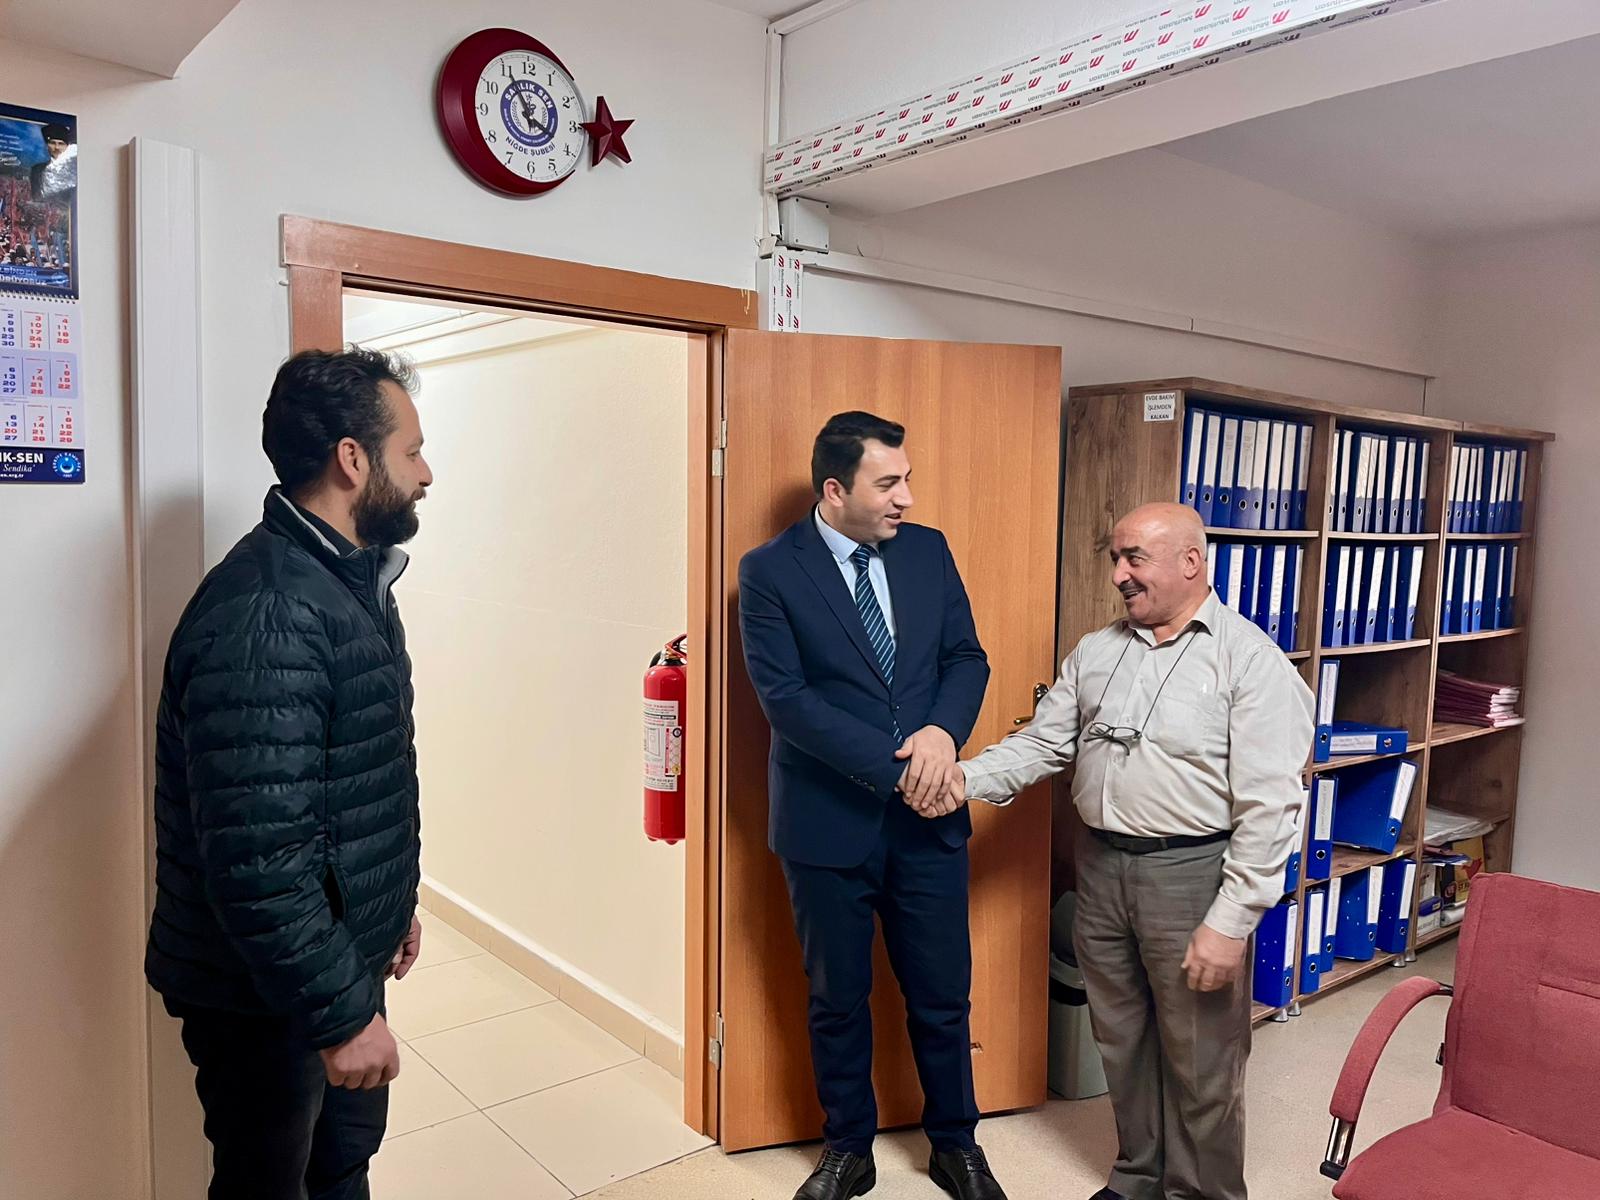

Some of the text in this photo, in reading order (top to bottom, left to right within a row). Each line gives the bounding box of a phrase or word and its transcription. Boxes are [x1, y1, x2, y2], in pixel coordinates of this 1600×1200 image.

[522, 62, 536, 76] 12
[548, 74, 552, 86] 1
[486, 81, 570, 108] 10 2
[538, 89, 553, 109] SEN
[480, 103, 577, 133] 9 3
[488, 129, 571, 156] 8 4
[506, 152, 556, 174] 7 6 5
